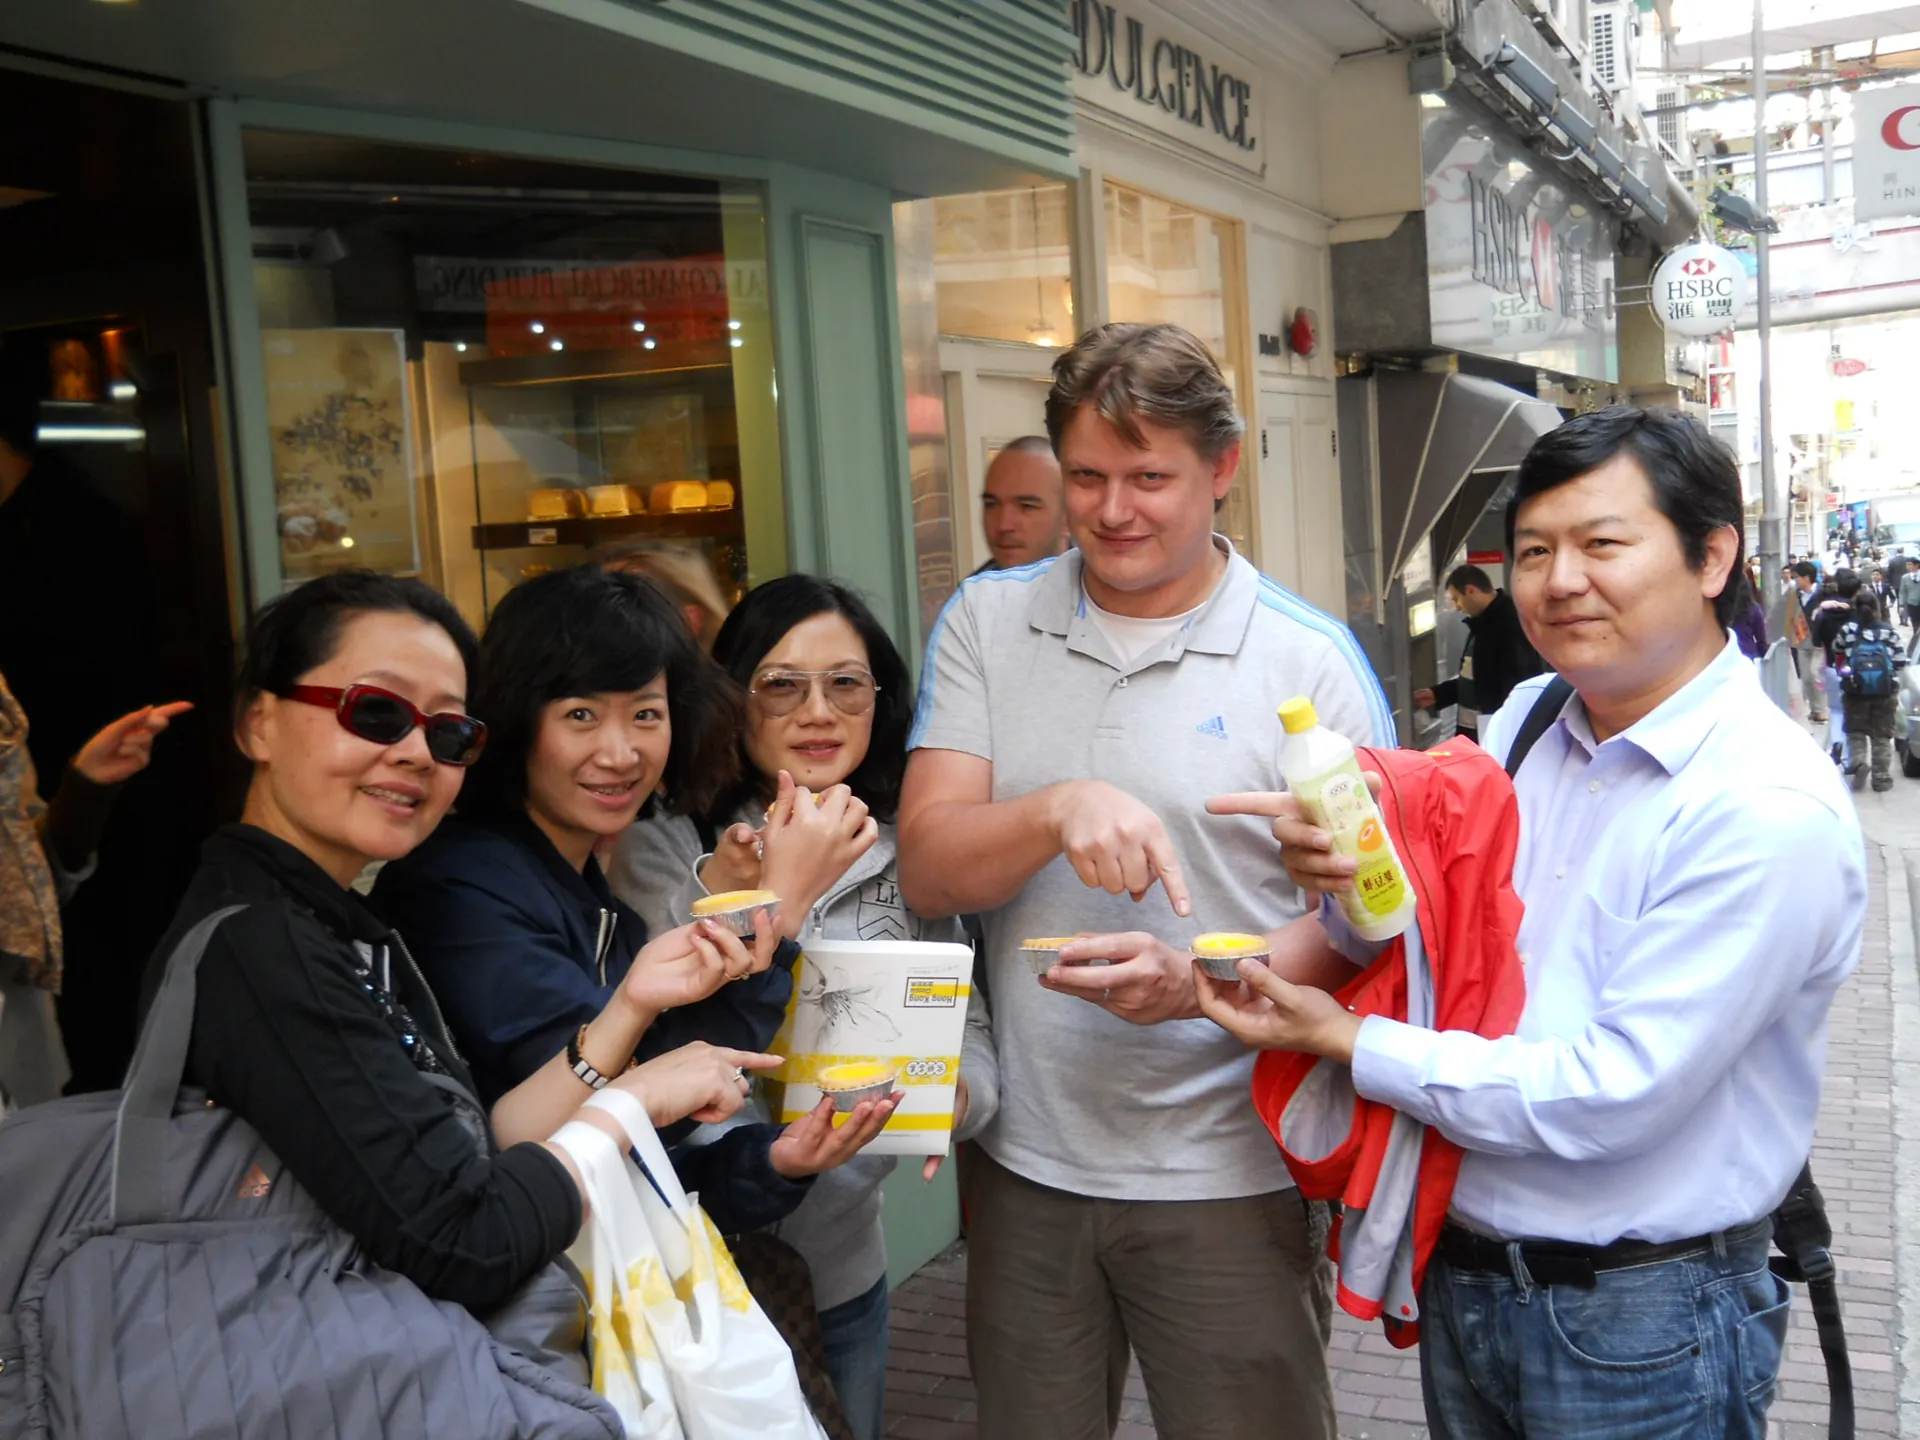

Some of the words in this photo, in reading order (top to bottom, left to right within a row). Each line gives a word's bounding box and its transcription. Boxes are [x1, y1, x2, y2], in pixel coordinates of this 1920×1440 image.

[1883, 186, 1920, 200] HIN
[1466, 170, 1530, 304] HSBC
[1666, 277, 1734, 300] HSBC
